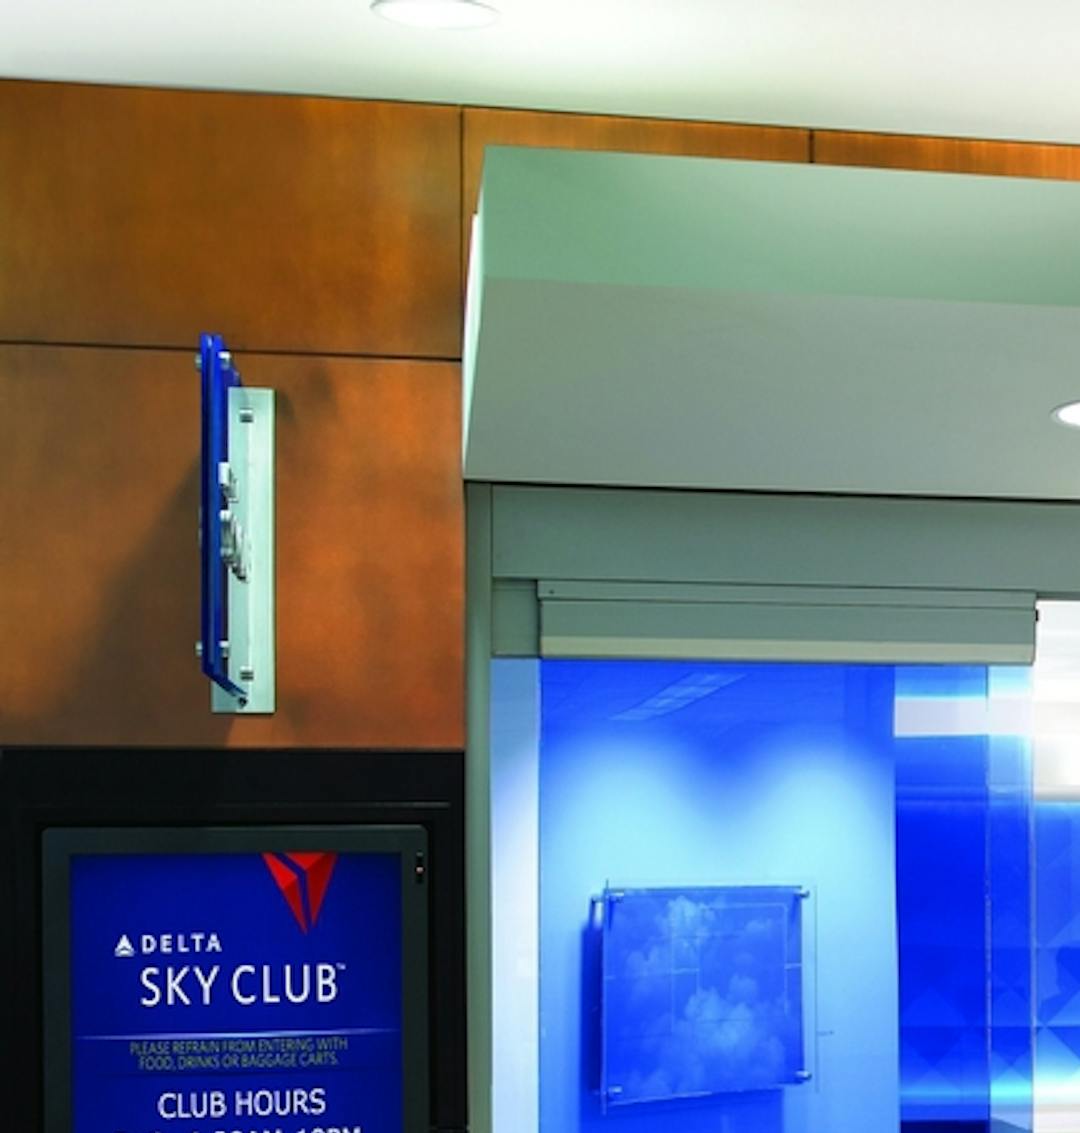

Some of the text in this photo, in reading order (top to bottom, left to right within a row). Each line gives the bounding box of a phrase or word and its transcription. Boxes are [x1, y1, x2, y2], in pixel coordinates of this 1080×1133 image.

[141, 934, 222, 954] DELTA
[140, 963, 339, 1006] SKY CLUB
[130, 1036, 348, 1056] PLEASE REFRAIN FROM ENTERING WITH
[178, 1053, 219, 1070] DRINKS
[222, 1053, 239, 1068] OR
[241, 1051, 297, 1068] BAGGAGE
[157, 1087, 326, 1119] CLUB HOURS
